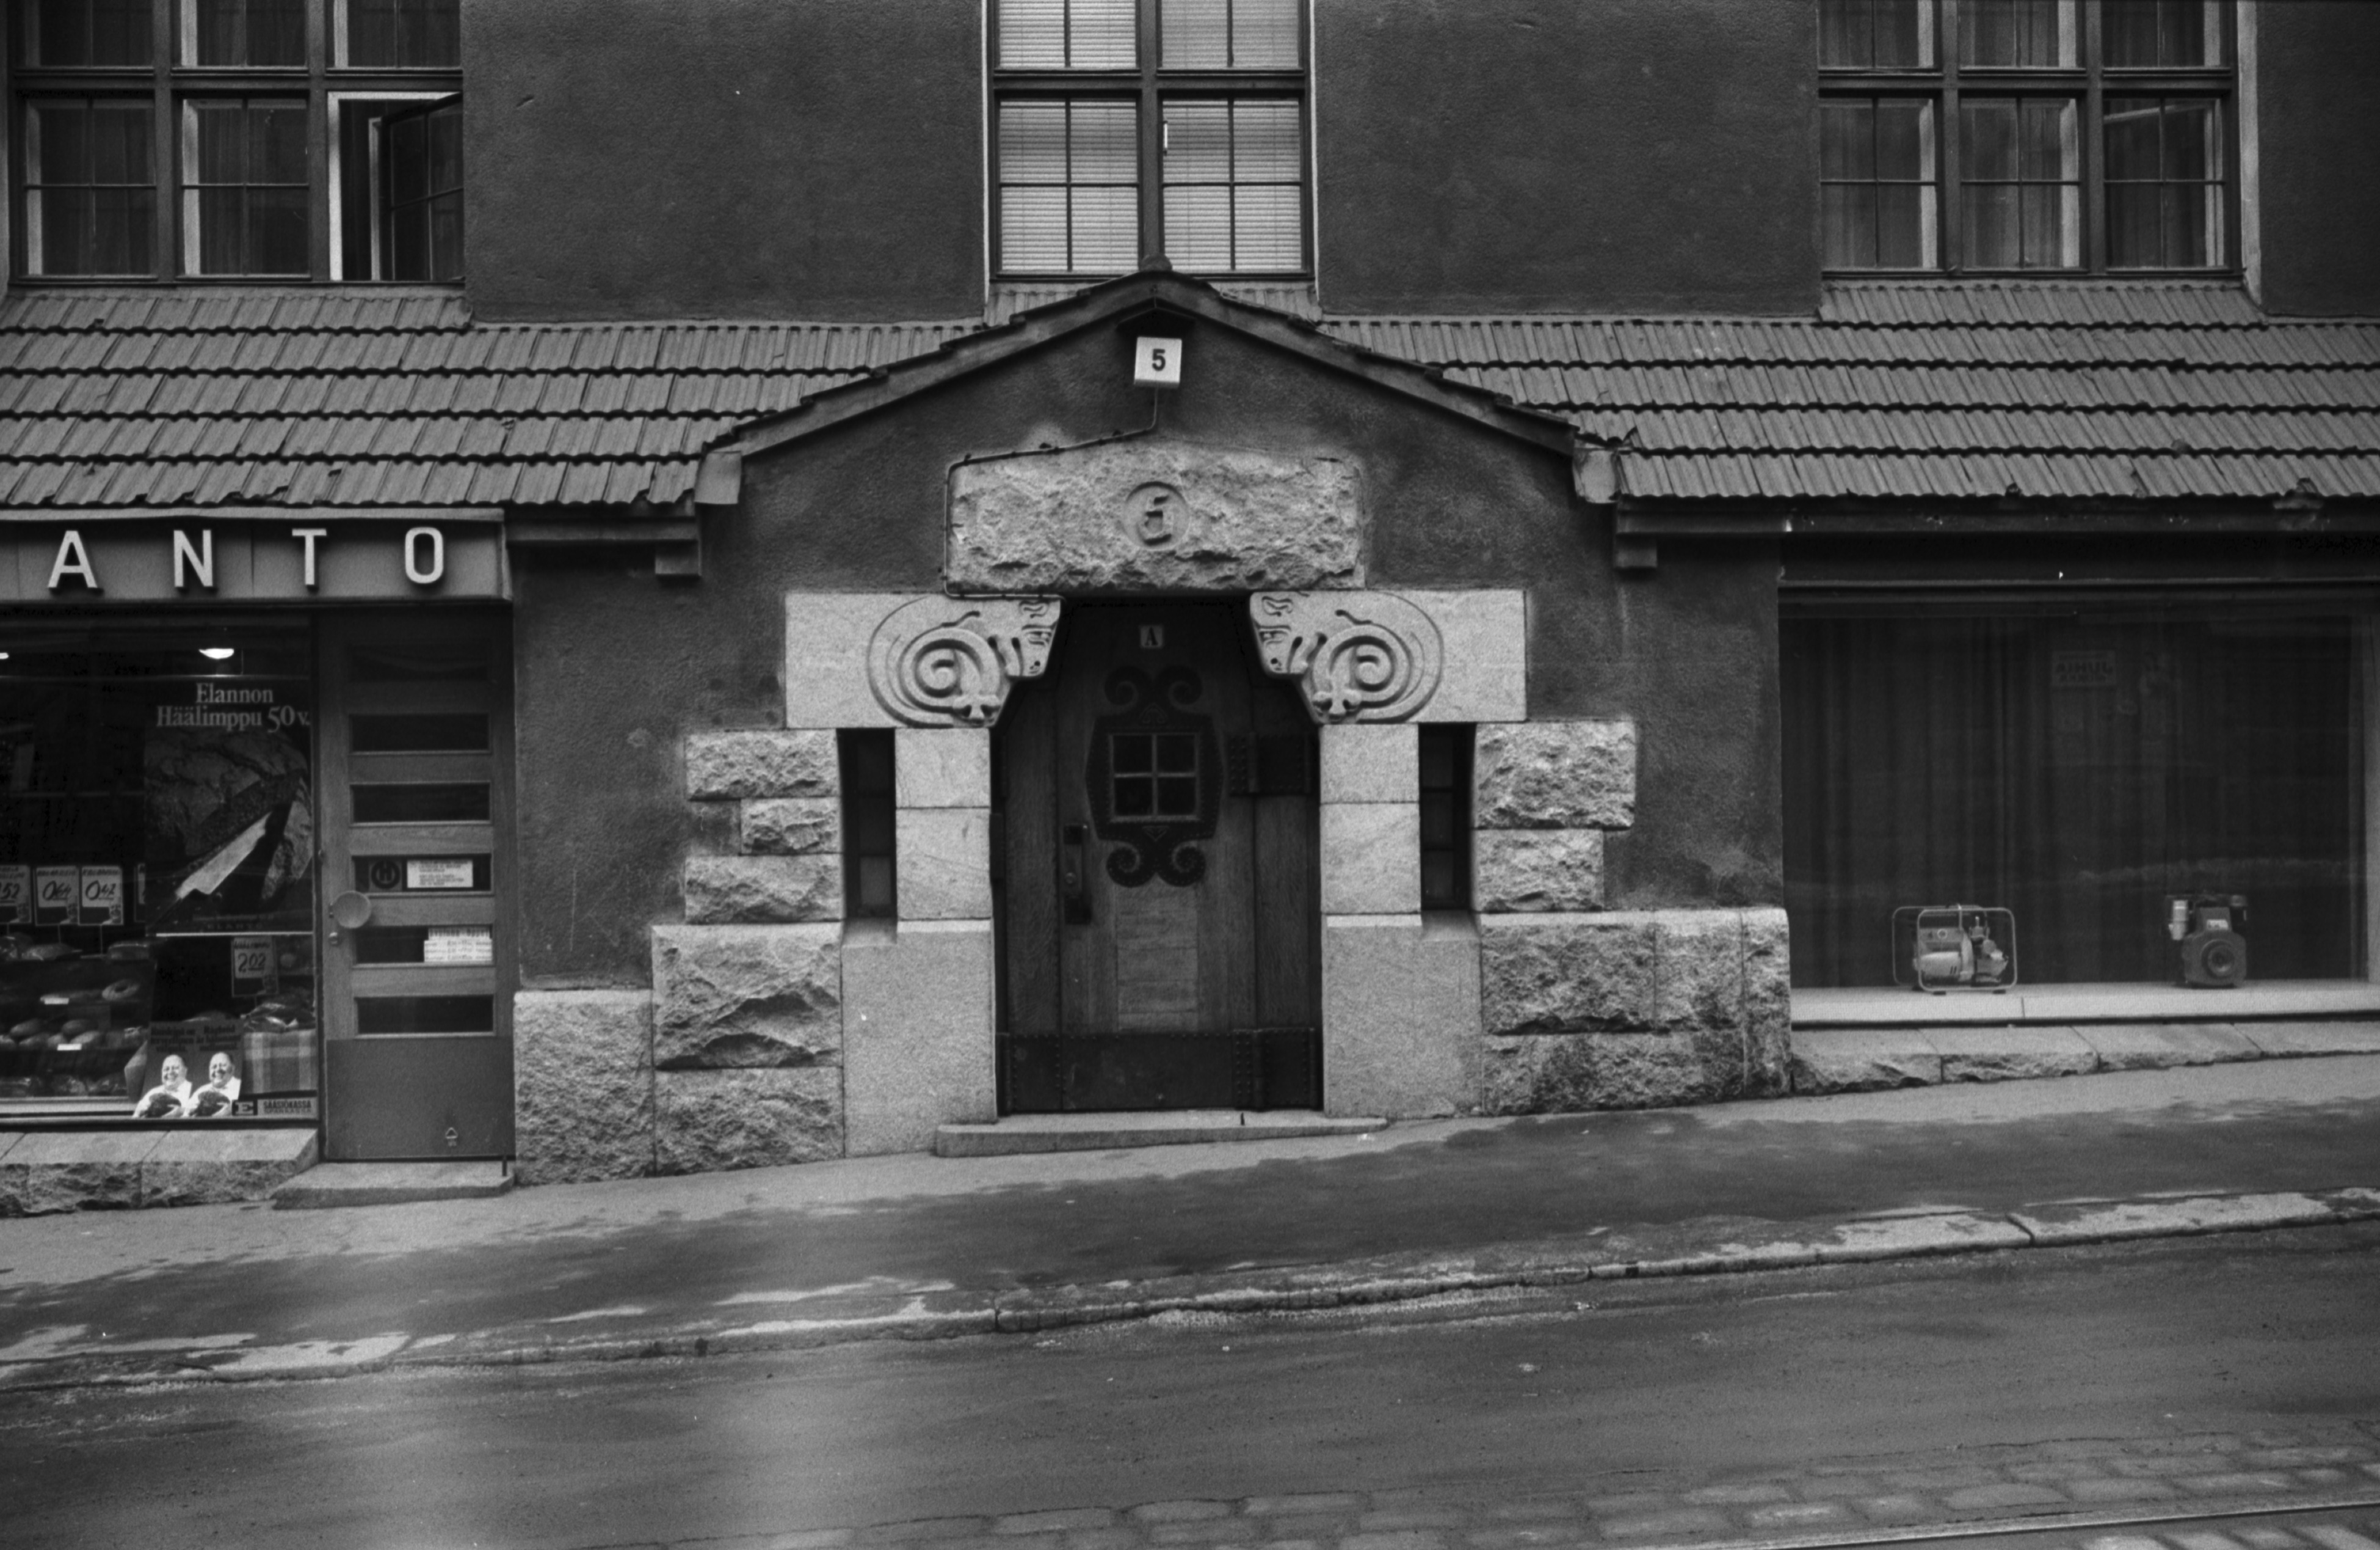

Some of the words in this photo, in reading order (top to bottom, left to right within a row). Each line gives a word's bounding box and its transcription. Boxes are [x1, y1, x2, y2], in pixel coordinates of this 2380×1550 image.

[1152, 348, 1166, 371] 5
[48, 526, 445, 589] ANTO
[1144, 627, 1158, 646] A
[195, 682, 274, 704] Elannon
[156, 705, 263, 732] Häälimppu
